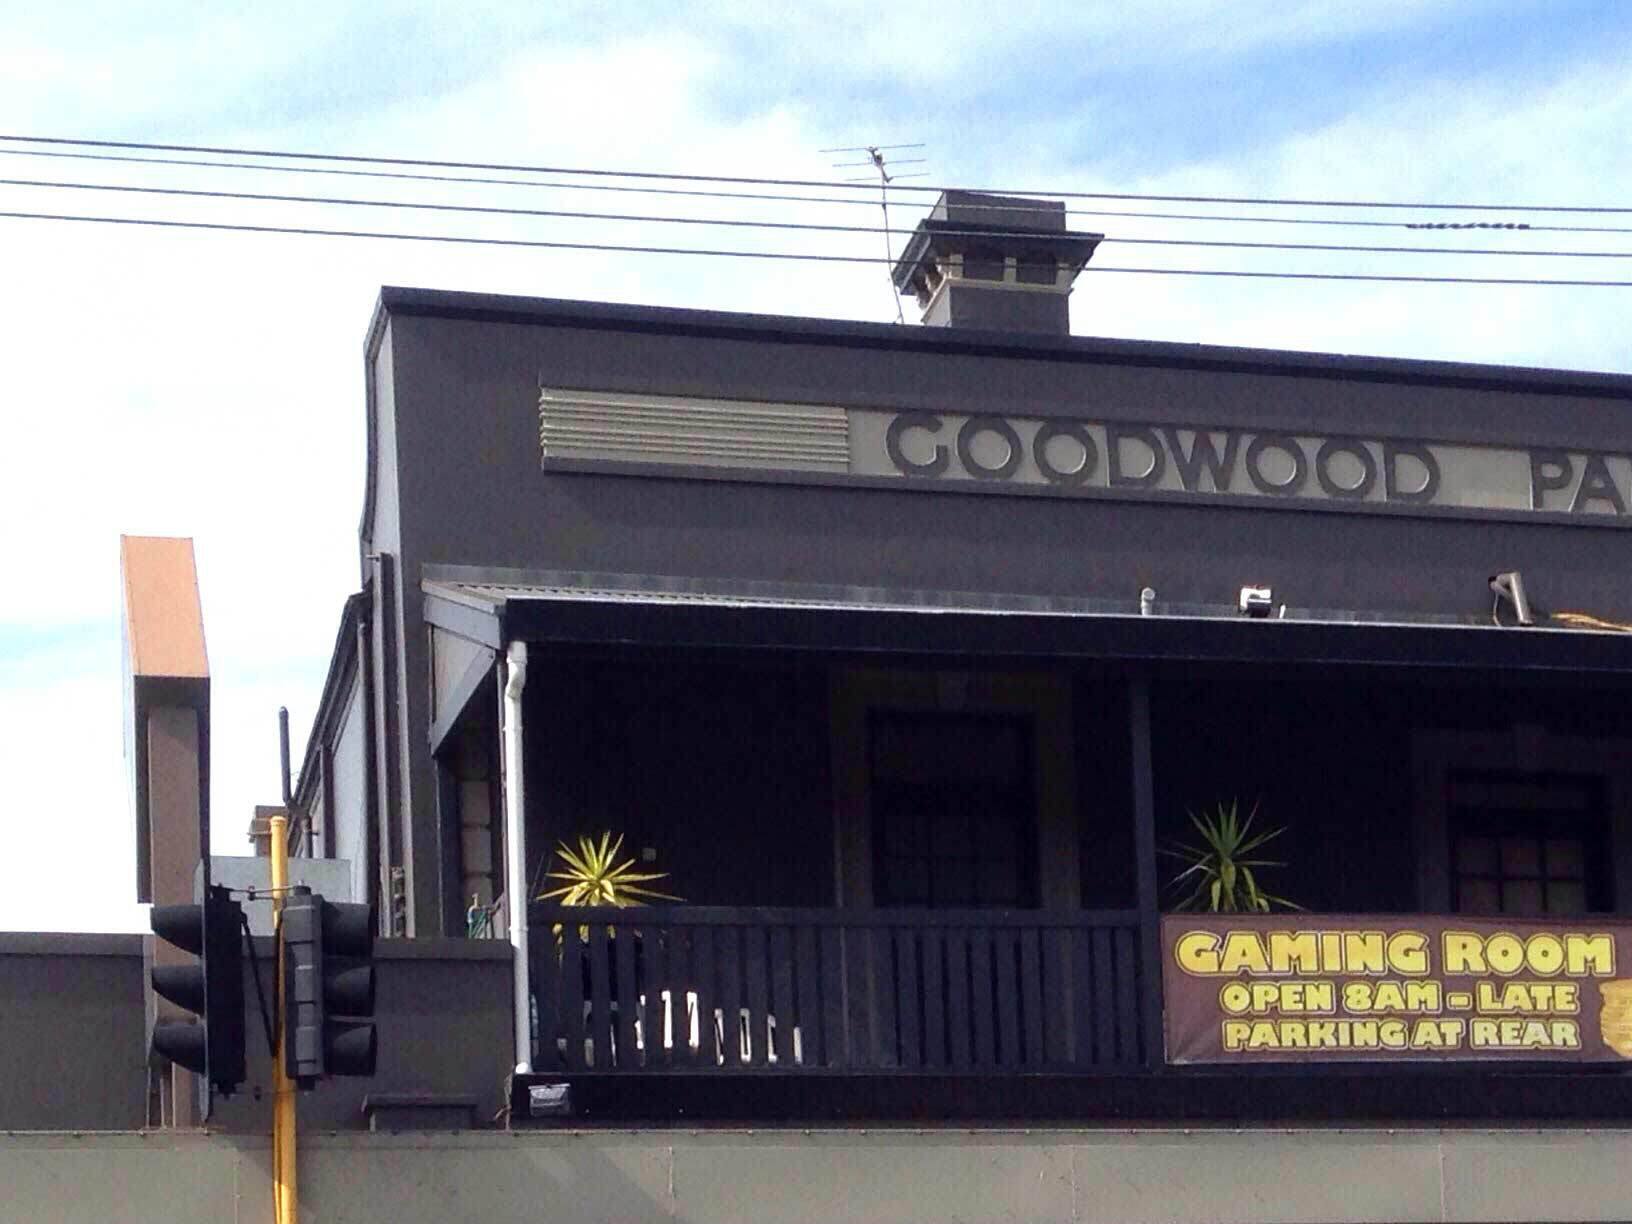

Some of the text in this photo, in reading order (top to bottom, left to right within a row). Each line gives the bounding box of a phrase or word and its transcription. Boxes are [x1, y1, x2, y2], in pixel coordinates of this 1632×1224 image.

[886, 411, 1441, 505] GOODWOOD
[1176, 931, 1616, 977] GAMING ROOM
[1220, 981, 1336, 1014] OPEN
[1342, 981, 1443, 1014] 8AM
[1477, 981, 1581, 1014] LATE
[1223, 1018, 1582, 1051] PARKING AT REAR
